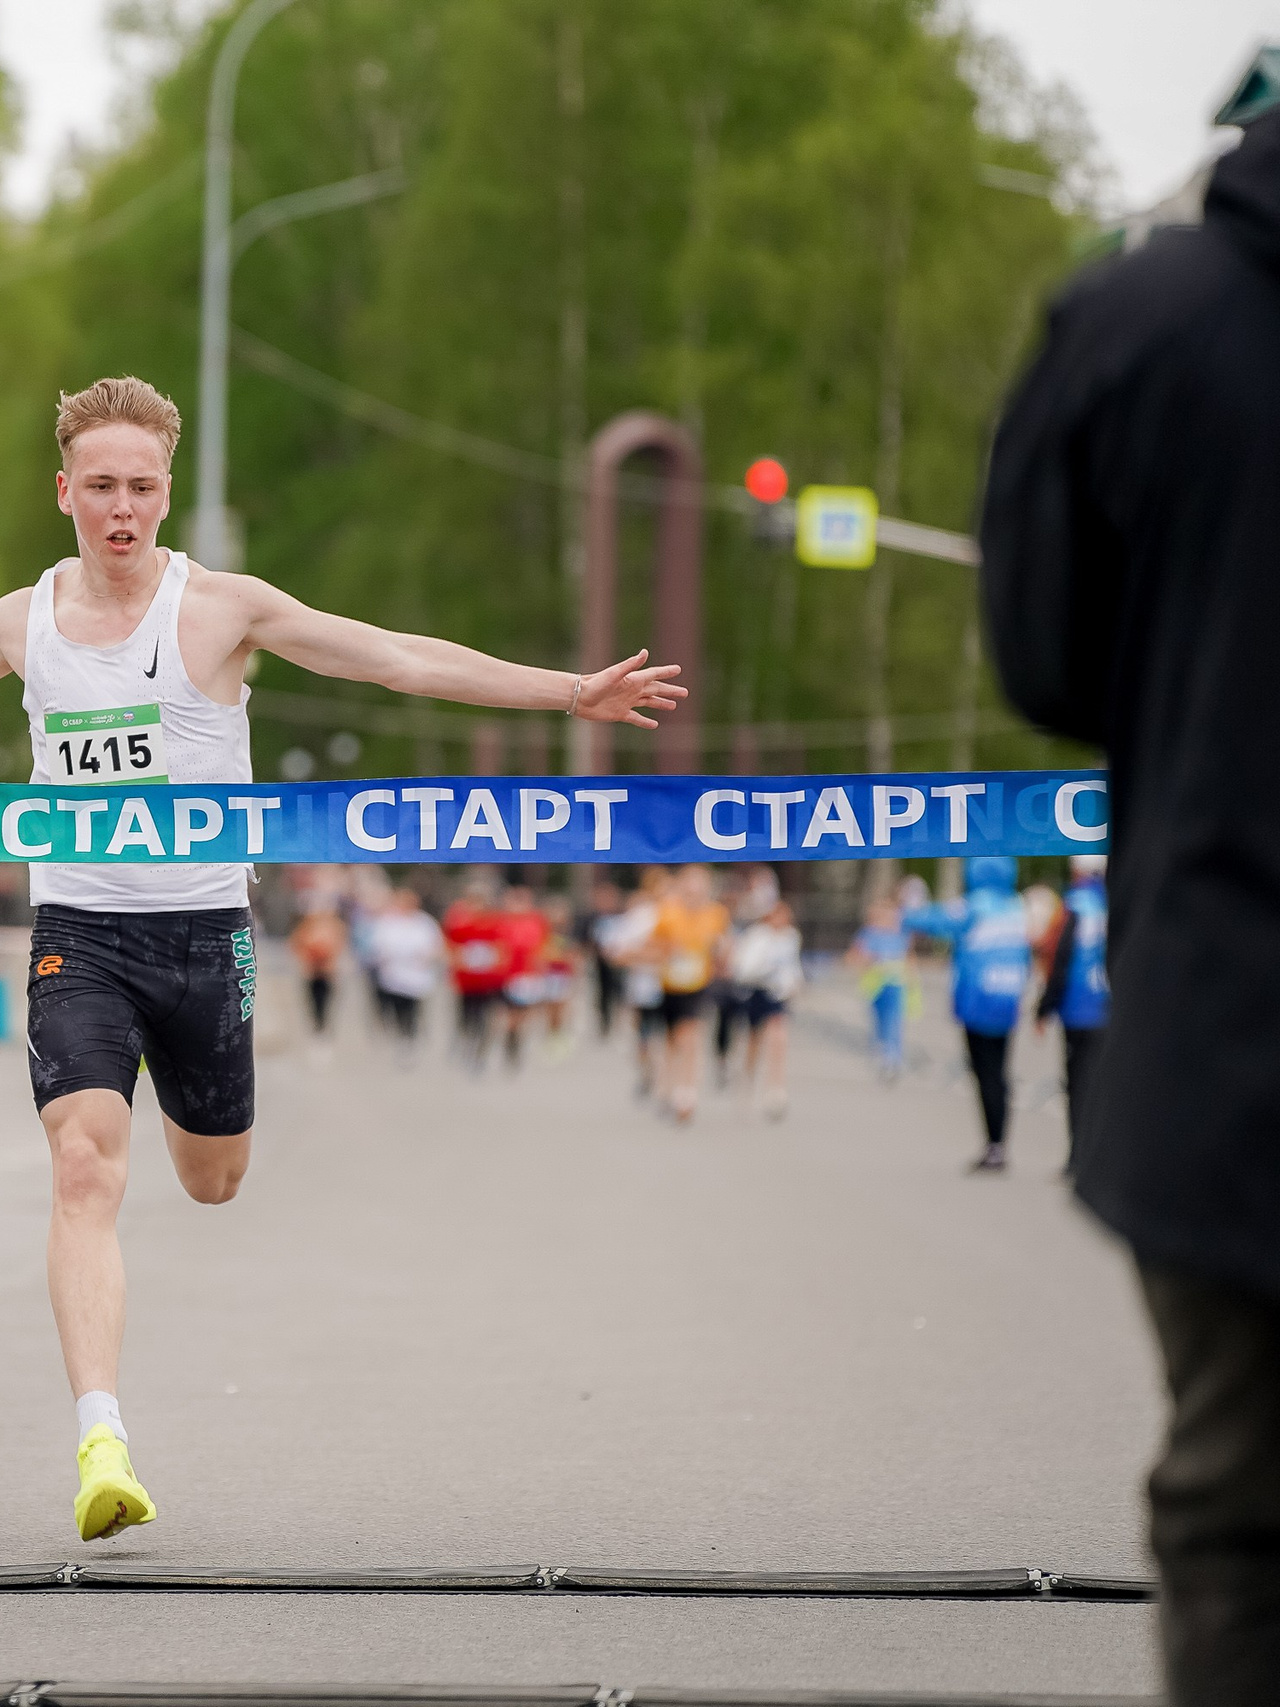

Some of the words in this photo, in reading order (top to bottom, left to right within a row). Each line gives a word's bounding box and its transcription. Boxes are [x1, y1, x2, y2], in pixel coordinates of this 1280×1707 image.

[58, 732, 153, 776] 1415
[1, 796, 281, 857] СТАРТ
[345, 787, 629, 852] СТАРТ
[694, 783, 986, 851] СТАРТ
[1054, 779, 1108, 842] С
